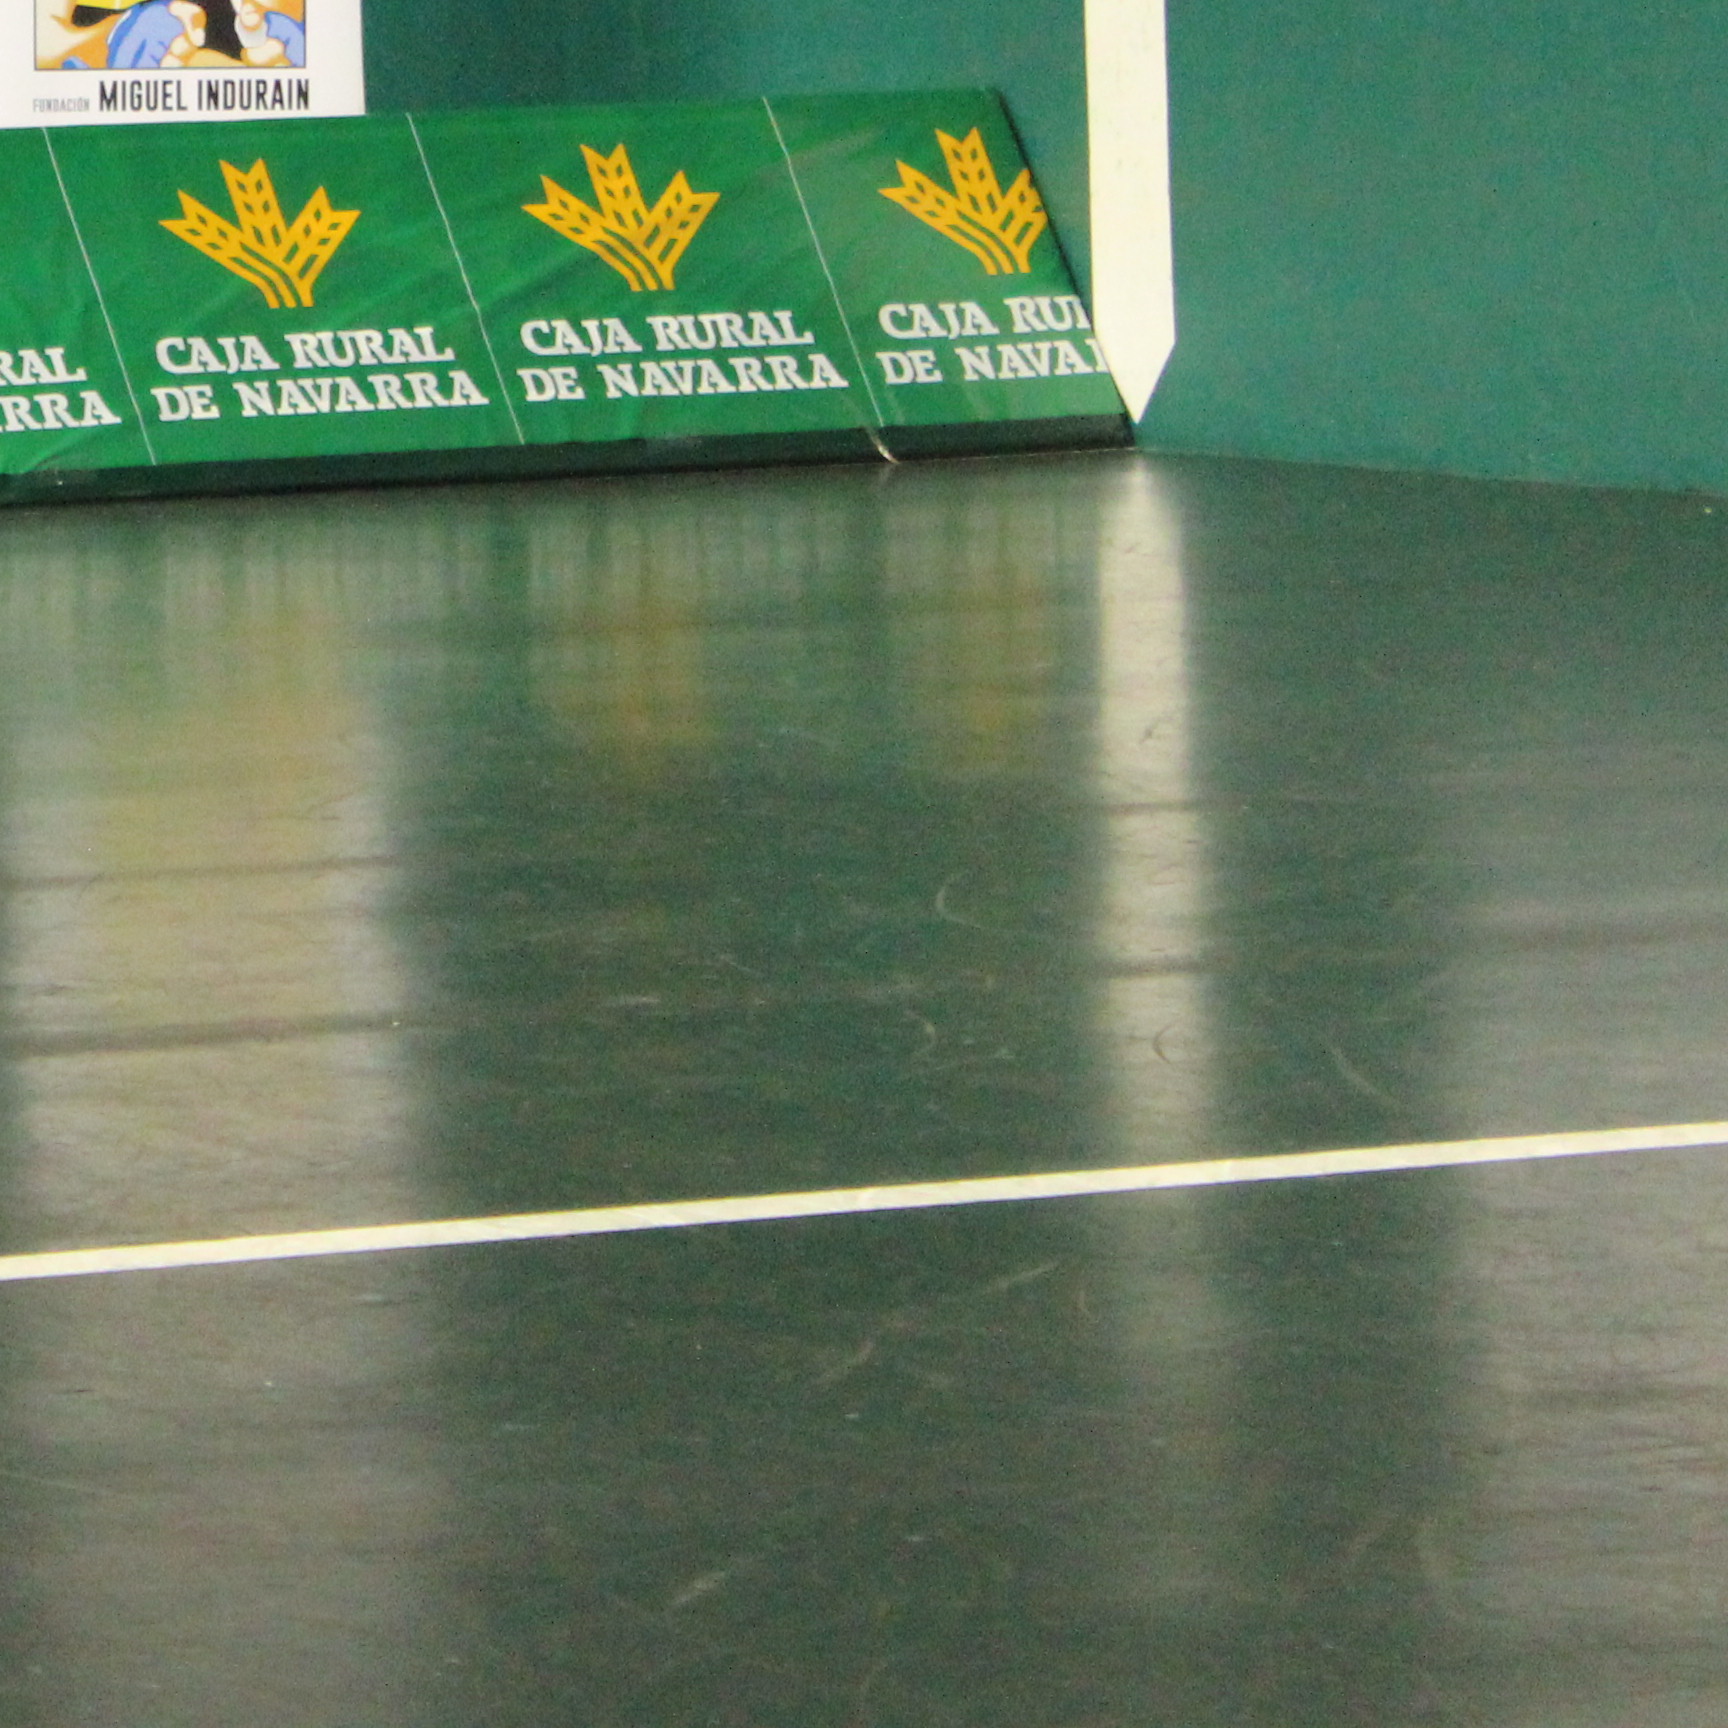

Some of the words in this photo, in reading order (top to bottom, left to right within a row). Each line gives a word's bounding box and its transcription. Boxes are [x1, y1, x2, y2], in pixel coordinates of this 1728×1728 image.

[33, 97, 90, 113] FUNDACIÓN
[99, 80, 188, 113] MIGUEL
[198, 78, 310, 112] INDURAIN
[521, 318, 642, 355] CAJA
[647, 311, 814, 350] RURAL
[879, 302, 999, 339] CAJA
[156, 336, 280, 373] CAJA
[291, 326, 454, 367] RURAL
[876, 350, 942, 383] DE
[151, 385, 219, 420] DE
[234, 371, 489, 416] NAVARRA
[517, 367, 584, 401] DE
[598, 354, 848, 398] NAVARRA
